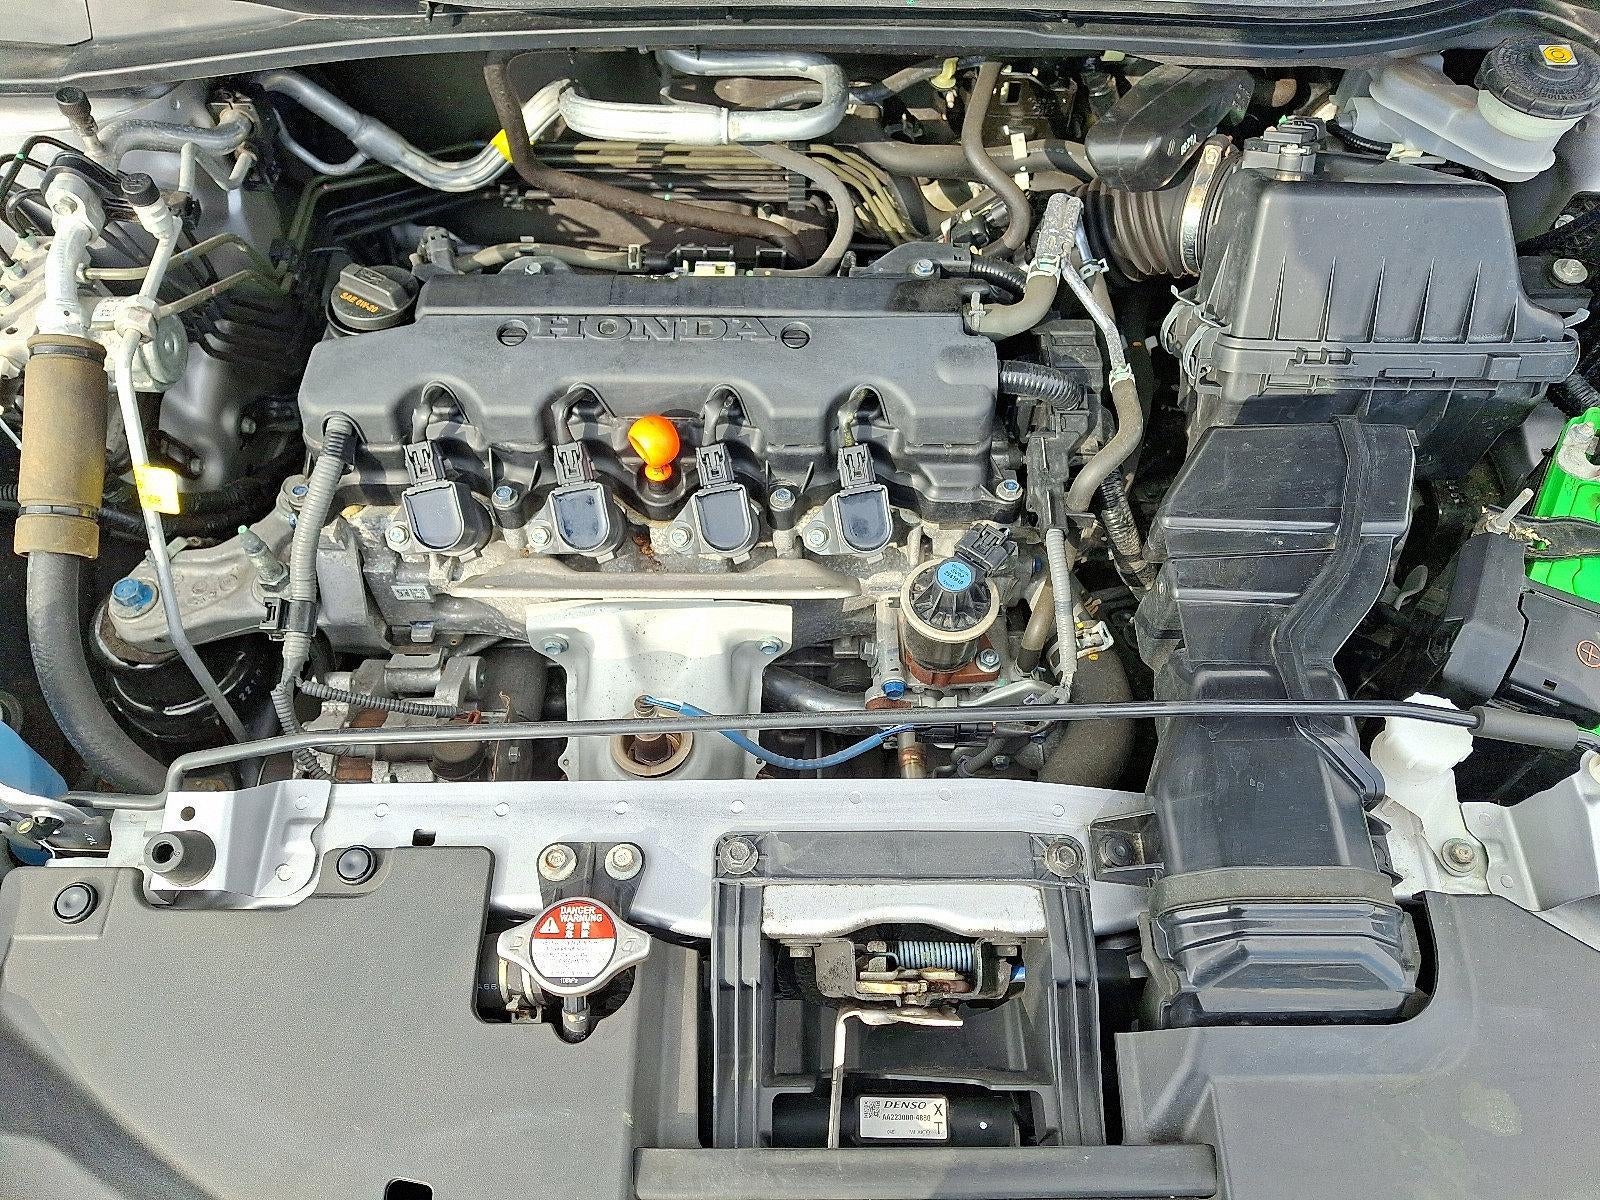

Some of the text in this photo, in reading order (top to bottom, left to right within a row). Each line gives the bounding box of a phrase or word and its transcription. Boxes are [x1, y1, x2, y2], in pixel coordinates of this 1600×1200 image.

[340, 292, 358, 303] SAE
[532, 315, 777, 342] HONDA
[560, 906, 596, 915] DANGER
[883, 1100, 927, 1110] DENSO
[933, 1103, 943, 1117] X
[933, 1121, 943, 1135] T
